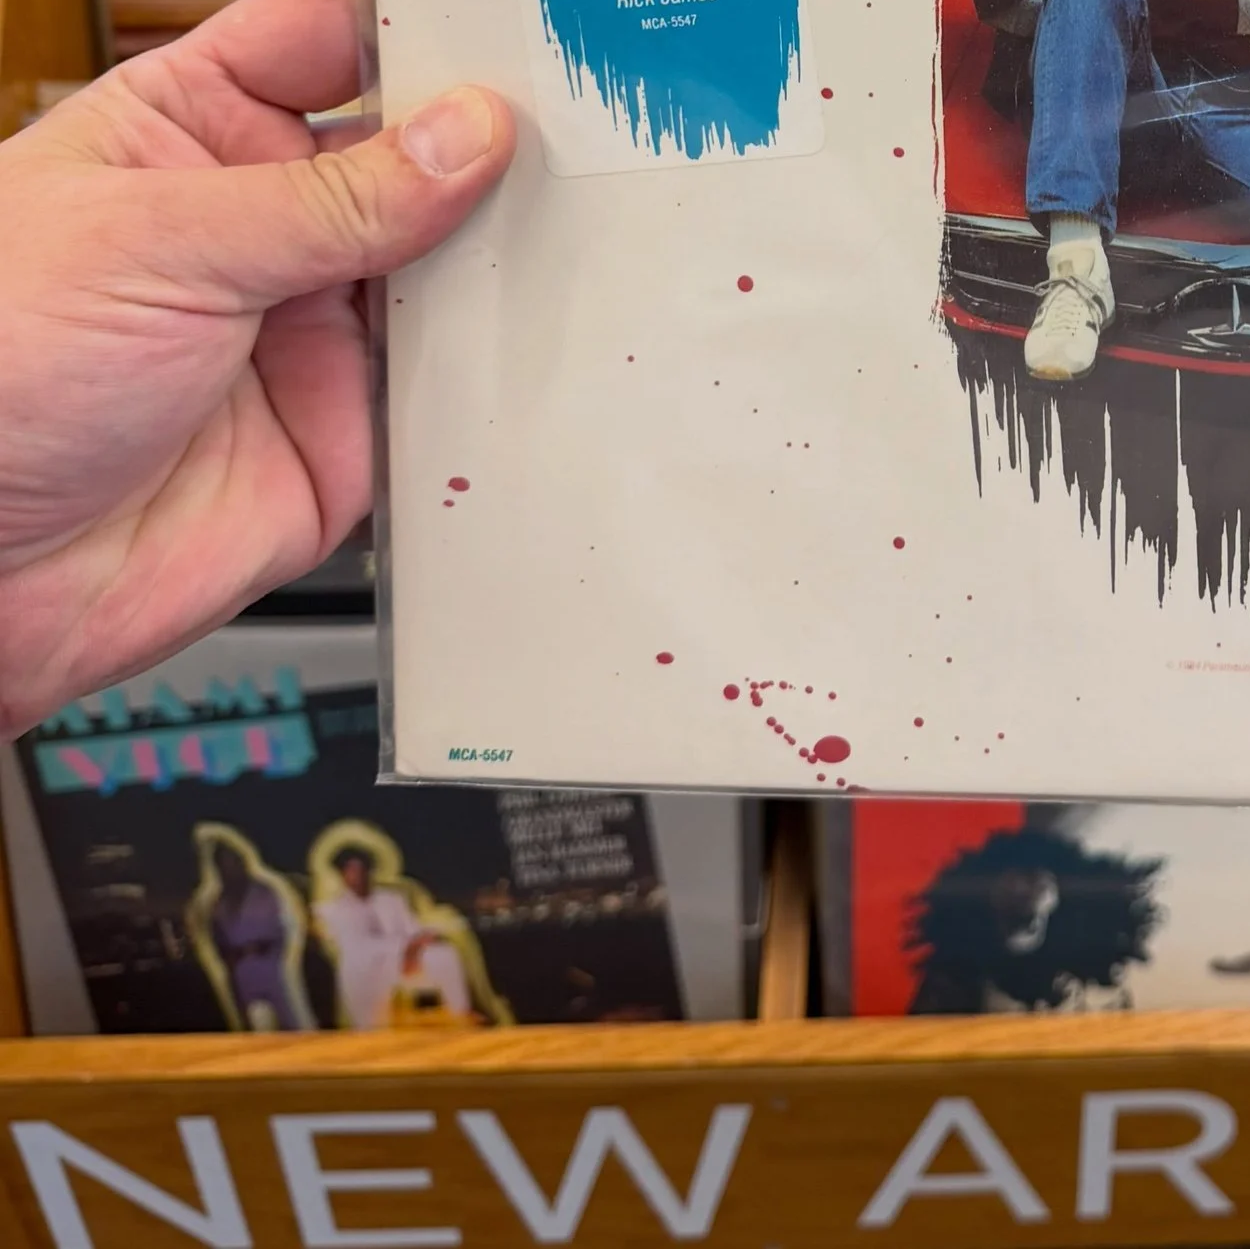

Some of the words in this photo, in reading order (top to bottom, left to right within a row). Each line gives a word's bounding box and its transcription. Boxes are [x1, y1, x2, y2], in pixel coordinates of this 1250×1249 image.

[641, 13, 698, 31] MCA-5547
[448, 748, 513, 762] MCA-5547
[9, 1103, 754, 1249] NEW
